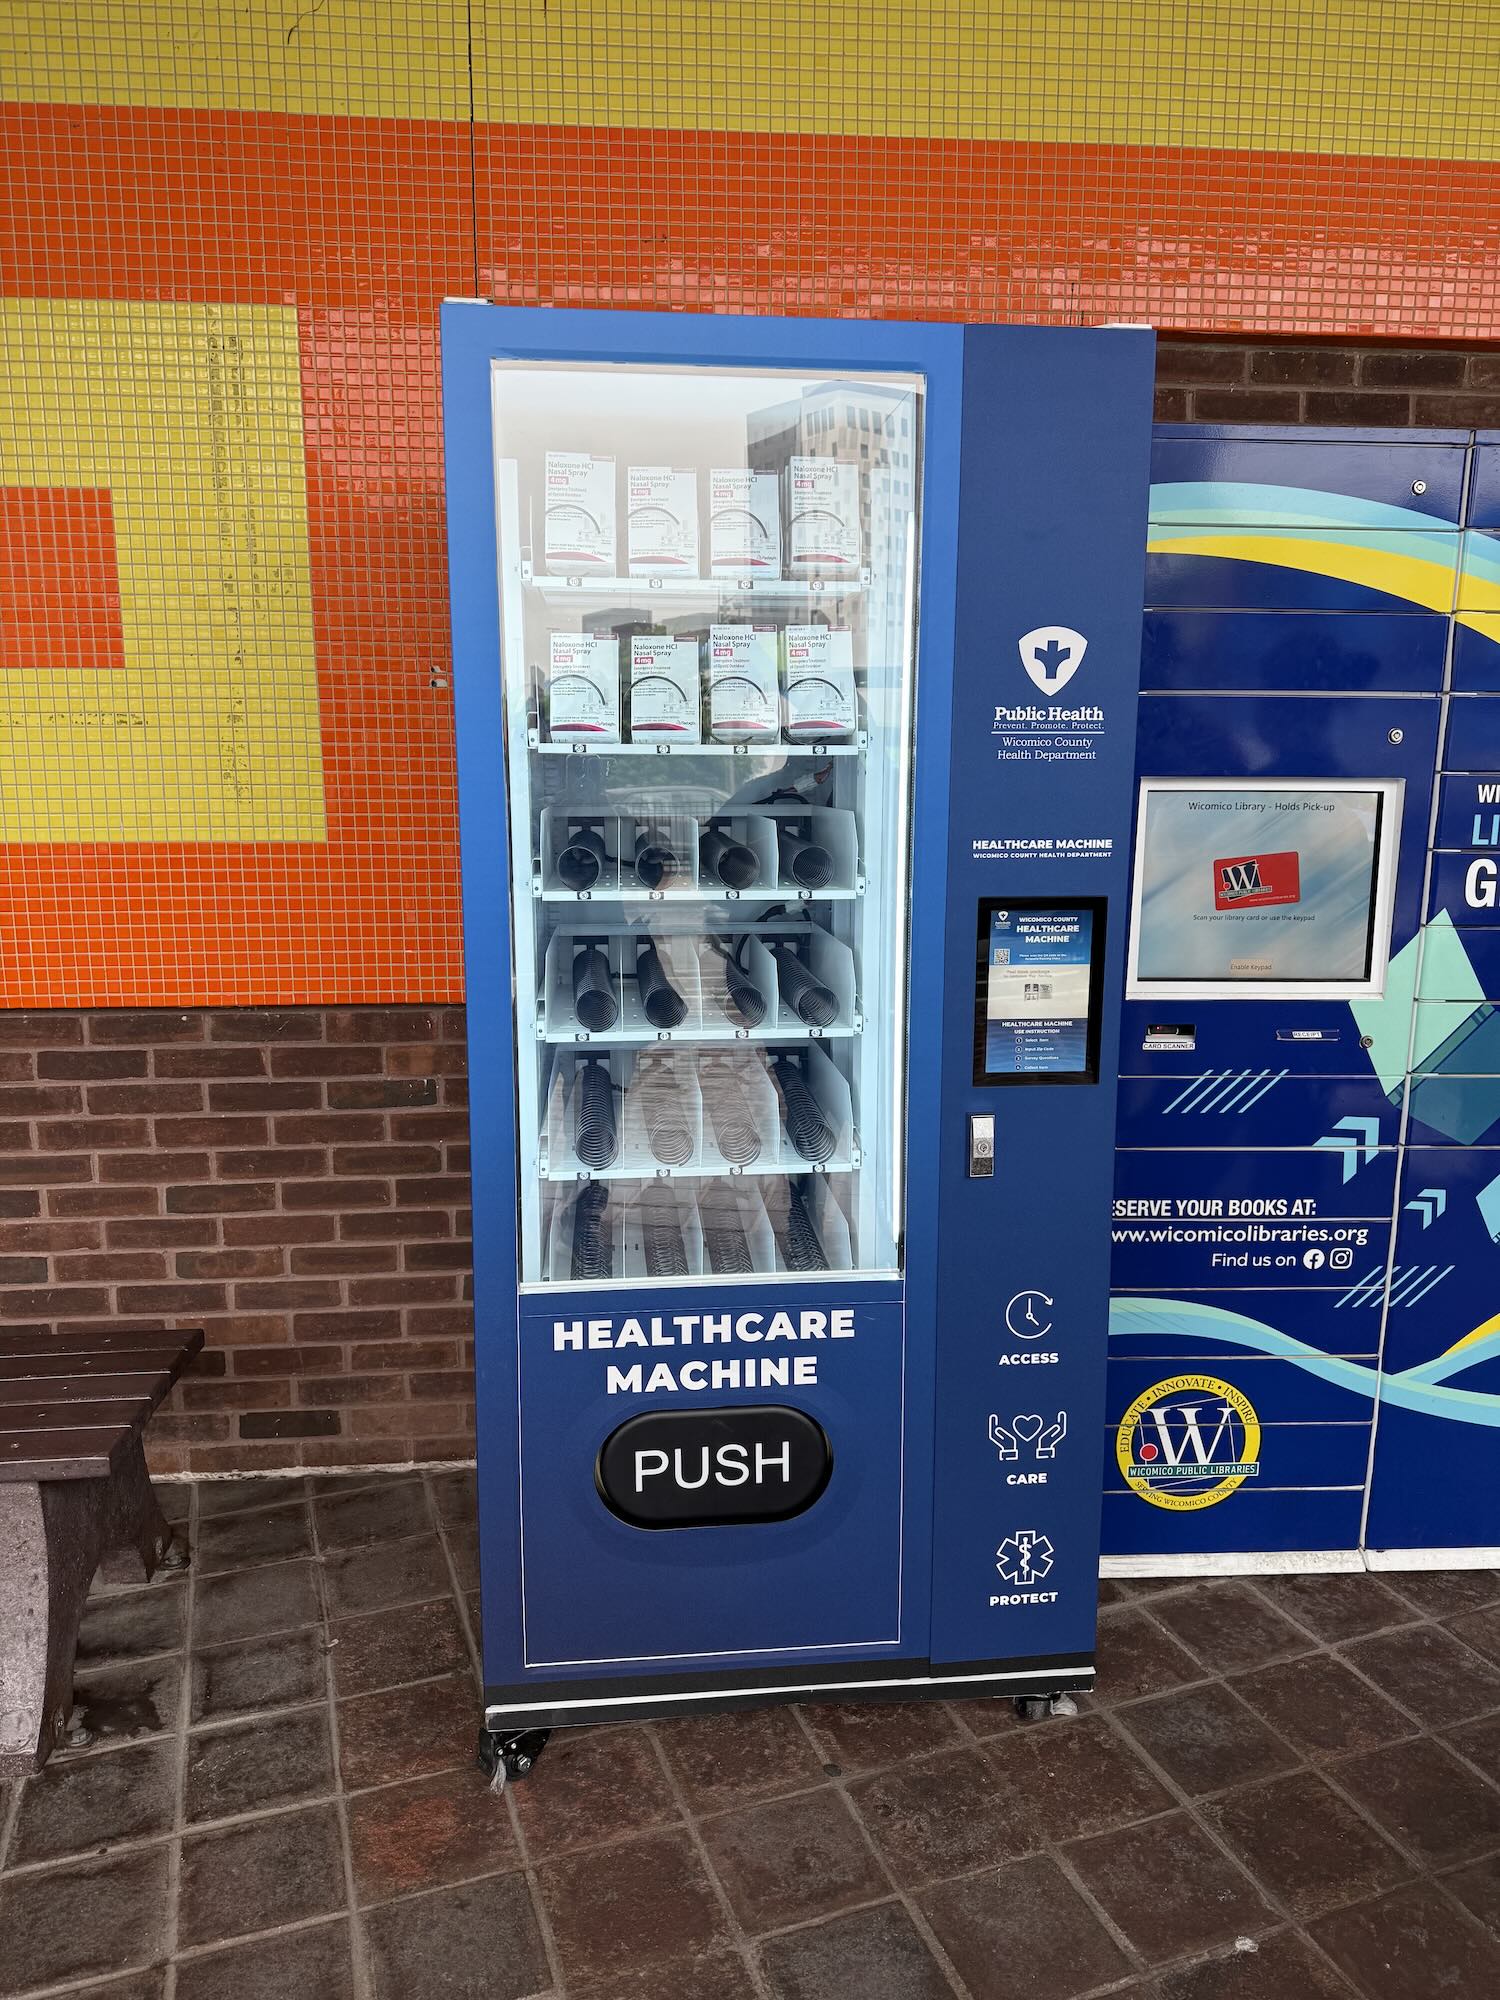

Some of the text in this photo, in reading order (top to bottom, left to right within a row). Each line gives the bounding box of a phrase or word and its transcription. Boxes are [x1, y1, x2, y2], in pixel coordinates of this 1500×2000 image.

[548, 461, 580, 470] Naloxone
[568, 469, 588, 478] Spray
[994, 706, 1104, 720] Public Health
[1002, 737, 1093, 749] Wicomico County
[998, 750, 1096, 762] Health Department
[1188, 802, 1232, 811] Wicomico
[1235, 802, 1266, 812] Library
[1275, 802, 1300, 811] Holds
[1303, 802, 1335, 812] Pick-up
[973, 839, 1112, 850] HEALTHCARE MACHINE
[1224, 864, 1260, 890] W
[1465, 858, 1500, 908] G
[1112, 1199, 1317, 1216] SERVE YOUR BOOKS AT:
[1212, 1252, 1296, 1267] Find us on
[553, 1309, 855, 1351] HEALTHCARE
[998, 1353, 1059, 1365] ACCESS
[607, 1356, 818, 1394] MACHINE
[1120, 1378, 1256, 1453] EDUCATE INNOVATE INSPIRE
[1143, 1408, 1236, 1464] W
[635, 1440, 790, 1493] PUSH
[1130, 1465, 1255, 1476] WICOMICO PUBLIC LIBRARIES
[1007, 1473, 1048, 1485] CARE
[1164, 1498, 1207, 1507] WICOMICO
[990, 1592, 1058, 1606] PROTECT
